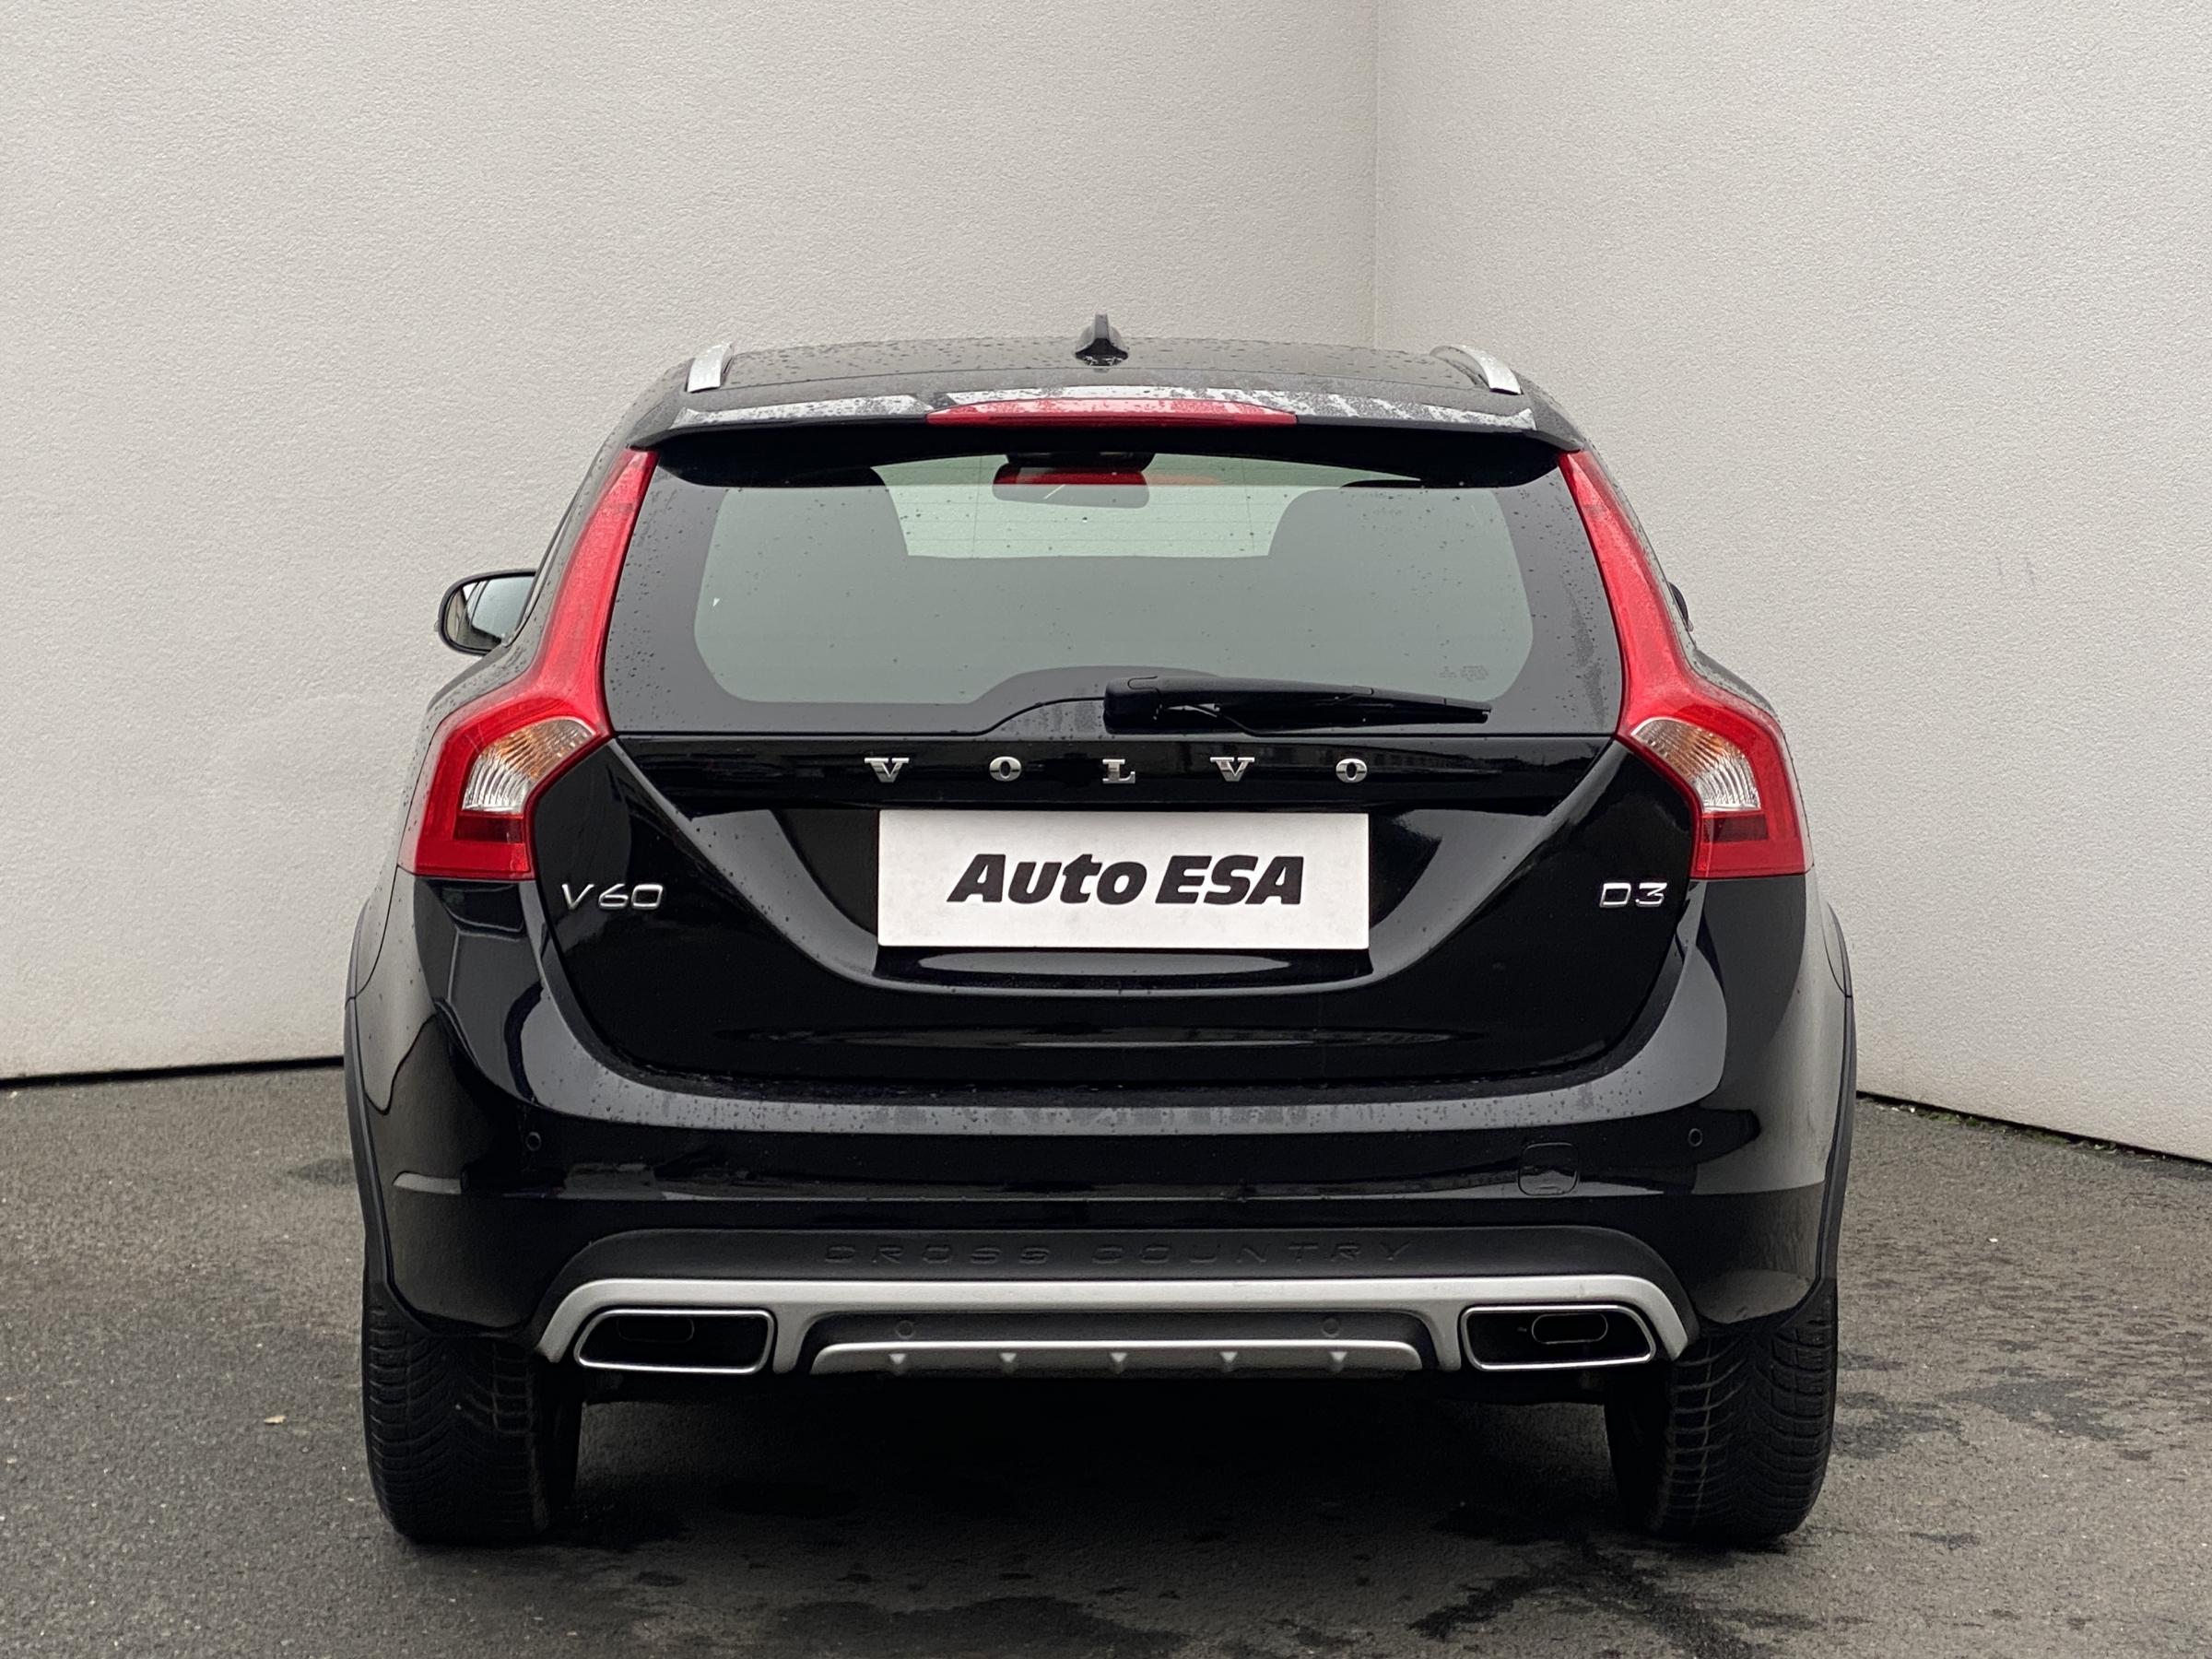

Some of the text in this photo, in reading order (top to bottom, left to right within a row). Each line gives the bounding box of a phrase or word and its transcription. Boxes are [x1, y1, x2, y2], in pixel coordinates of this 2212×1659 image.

[865, 757, 1368, 783] VOLVO
[947, 853, 1304, 905] Auto ESA
[561, 883, 664, 910] V60
[1599, 882, 1667, 907] D3
[824, 1241, 1412, 1265] CROSS COUNTRY
